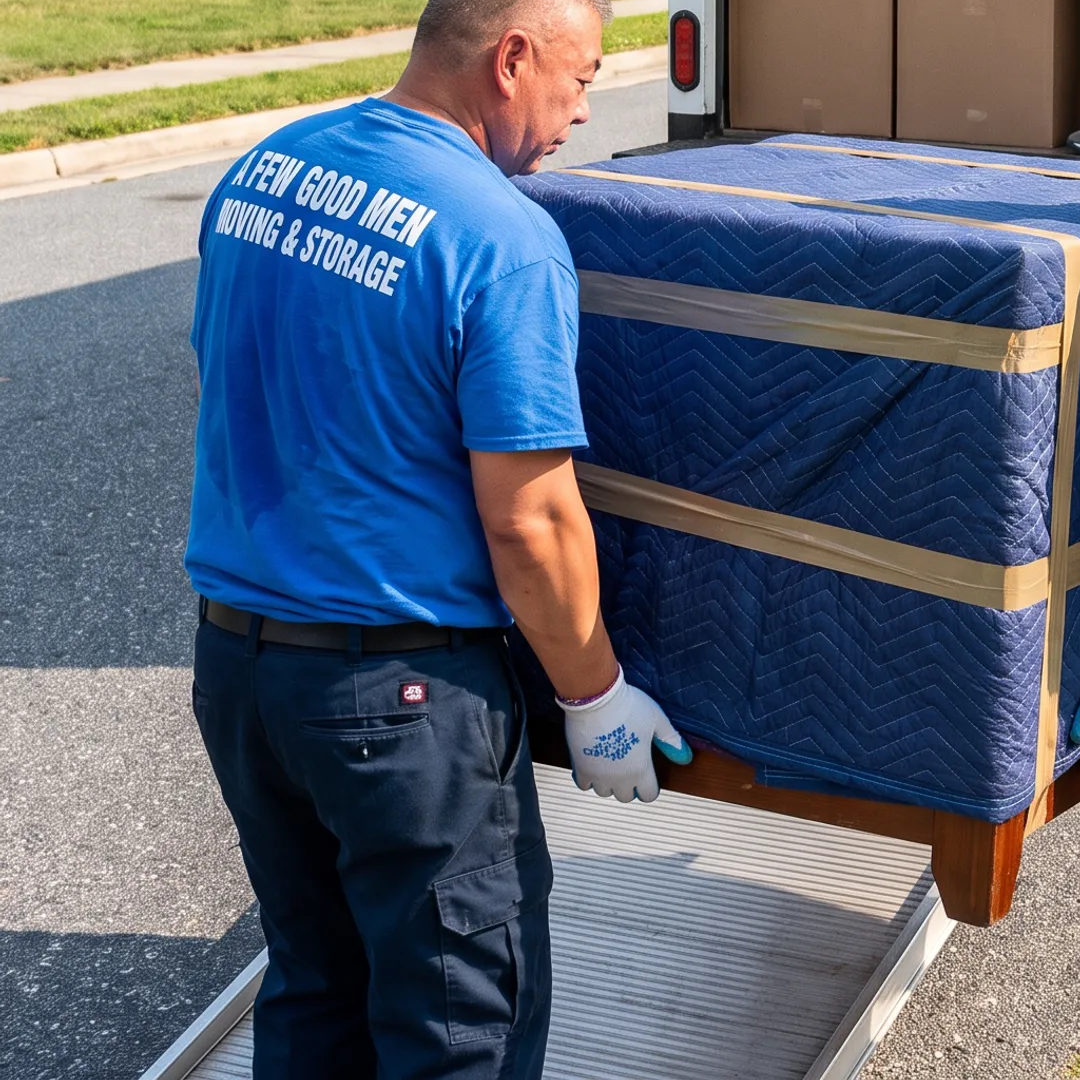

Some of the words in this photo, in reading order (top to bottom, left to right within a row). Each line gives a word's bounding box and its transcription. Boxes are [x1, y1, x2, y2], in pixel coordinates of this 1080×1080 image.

[215, 198, 284, 250] MOVING
[280, 218, 303, 257] &
[300, 224, 406, 297] STORAGE
[231, 149, 258, 186] A
[245, 150, 306, 198] FEW
[295, 165, 368, 220] GOOD
[357, 187, 438, 248] MEN
